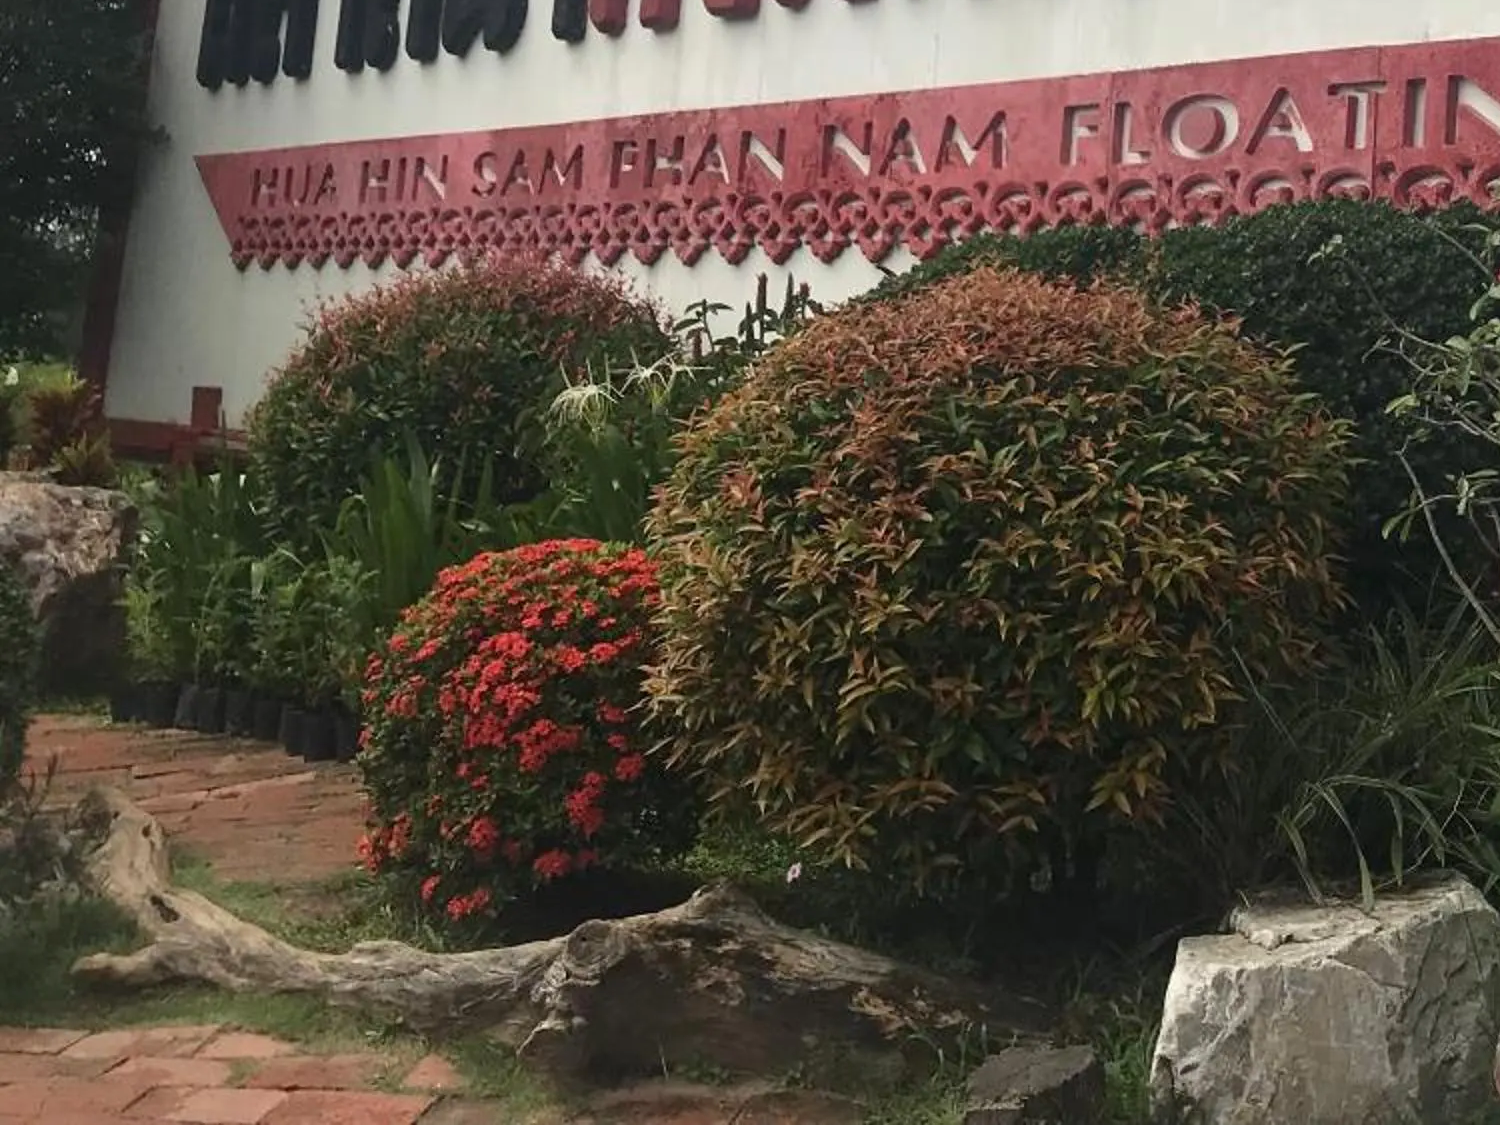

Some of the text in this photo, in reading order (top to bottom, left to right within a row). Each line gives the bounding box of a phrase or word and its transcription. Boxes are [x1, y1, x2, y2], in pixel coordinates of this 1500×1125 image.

[250, 162, 337, 207] HUA
[358, 153, 449, 203] HIN
[471, 143, 584, 199] SAM
[609, 127, 786, 189] PHAN
[821, 109, 1009, 179] NAM
